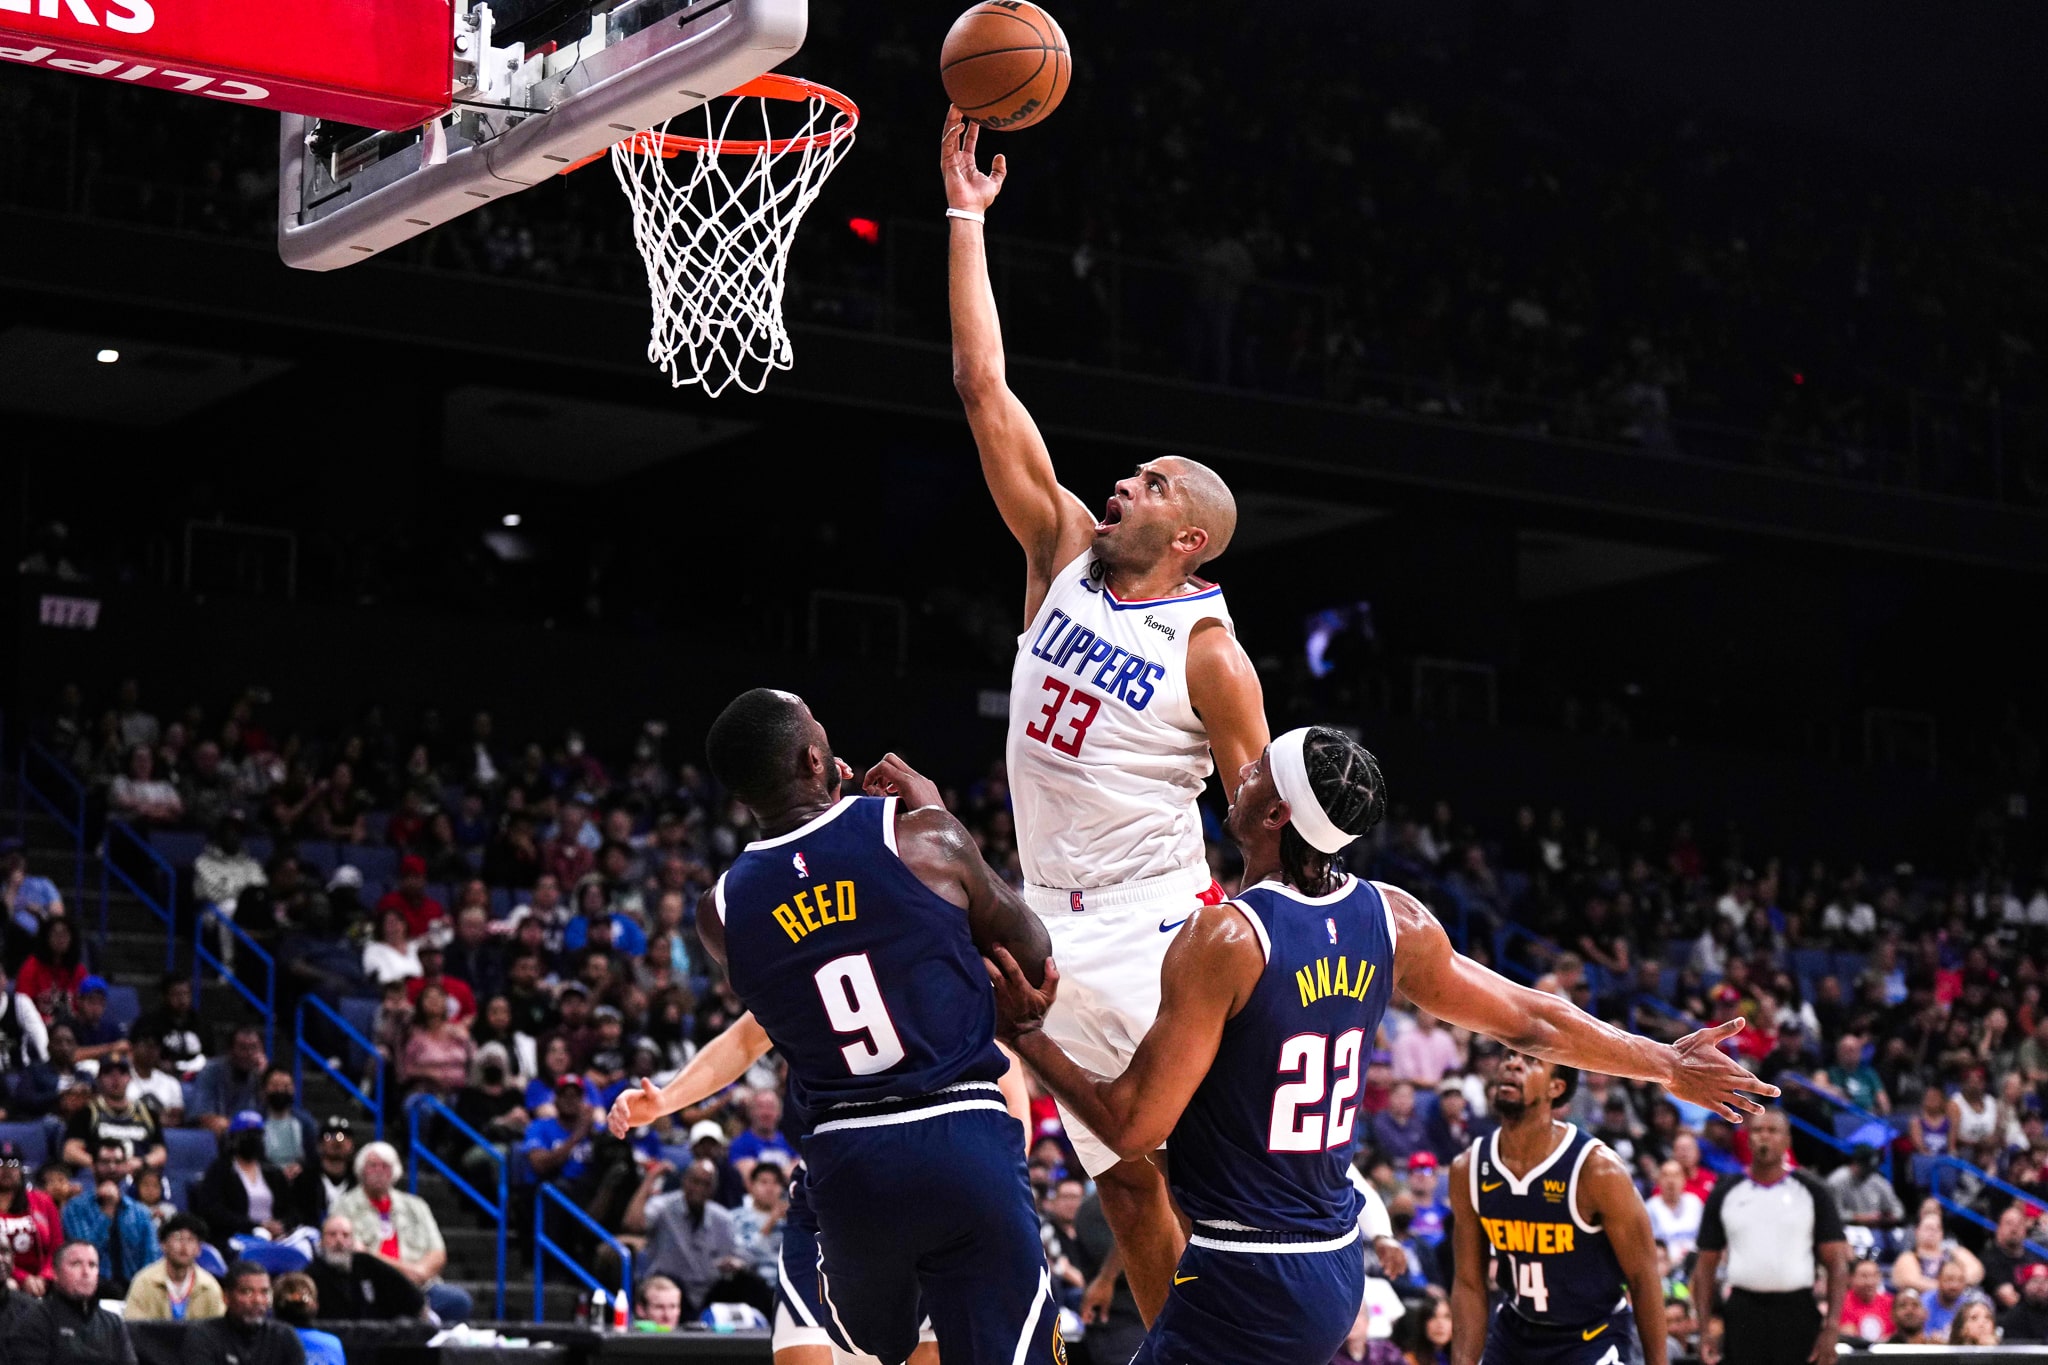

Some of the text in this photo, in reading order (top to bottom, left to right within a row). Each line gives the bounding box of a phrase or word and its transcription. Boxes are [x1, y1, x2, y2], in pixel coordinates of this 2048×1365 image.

[1031, 607, 1165, 711] CLIPPERS
[1144, 614, 1176, 641] honey
[1026, 675, 1102, 758] 33
[772, 880, 856, 943] REED
[813, 950, 906, 1077] 9
[1296, 956, 1377, 1007] NNAJI
[1267, 1028, 1366, 1154] 22
[1543, 1179, 1566, 1193] WU
